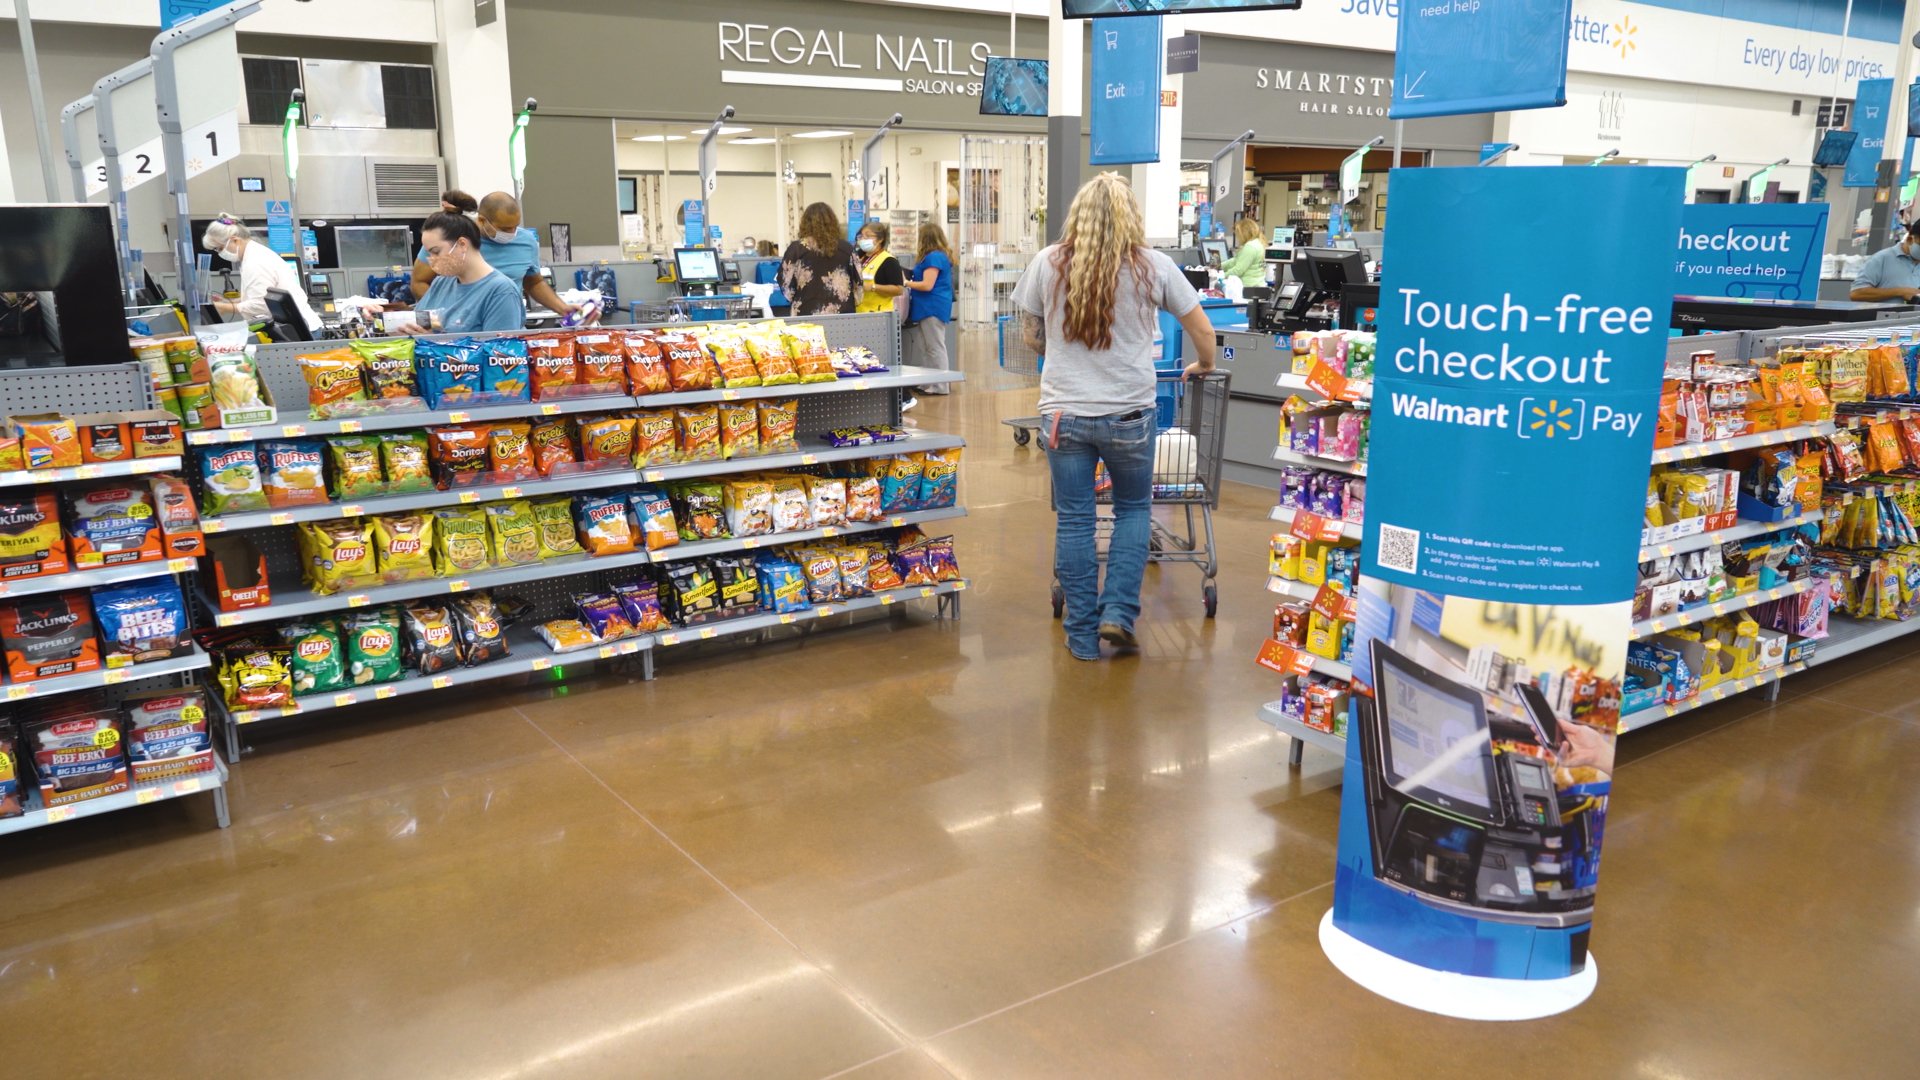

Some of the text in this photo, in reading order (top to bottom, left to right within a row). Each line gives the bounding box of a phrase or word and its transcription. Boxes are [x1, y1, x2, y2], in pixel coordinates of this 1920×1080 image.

[1420, 1, 1480, 17] need help
[718, 22, 992, 77] REGAL NAILS
[1744, 38, 1786, 74] Every
[1790, 45, 1815, 78] day
[905, 79, 953, 95] SALON
[1106, 83, 1126, 99] Exit
[1300, 102, 1338, 114] HAIR
[206, 131, 218, 156] 1
[1862, 139, 1884, 148] Exit
[136, 154, 151, 173] 2
[97, 166, 107, 182] 3
[708, 180, 714, 190] 6
[871, 180, 877, 190] 7
[1220, 186, 1226, 195] 9
[1688, 265, 1713, 277] you
[1716, 264, 1751, 276] need
[1755, 264, 1787, 280] help
[1398, 288, 1653, 334] Touch-free
[372, 360, 411, 371] Doritos
[489, 355, 528, 367] Doritos
[537, 356, 574, 367] Doritos
[585, 354, 623, 364] Doritos
[1395, 337, 1612, 384] checkout
[440, 362, 480, 373] Doritos
[317, 367, 360, 390] Cheetos
[1391, 392, 1642, 438] Walmart Pay
[209, 450, 255, 470] RUFFLES
[272, 451, 320, 468] RUFFLES
[87, 518, 138, 530] BEEF JERKY
[391, 538, 419, 553] Lay's
[1432, 533, 1447, 542] Scan
[1448, 536, 1460, 544] this
[1502, 543, 1536, 551] download
[335, 546, 365, 561] Lay's
[1464, 554, 1485, 562] select
[1486, 556, 1517, 566] Services,
[1582, 560, 1593, 568] Pay
[1428, 571, 1444, 579] Scan
[684, 585, 715, 603] Smartfood
[725, 581, 758, 596] Smartfood
[120, 608, 165, 628] BEEF
[15, 622, 45, 634] JACK
[118, 621, 175, 641] BITES
[426, 626, 450, 641] Lay's
[477, 620, 495, 633] Lay's
[27, 636, 75, 652] PEPPERED
[300, 640, 330, 655] Lay's
[361, 634, 391, 649] Lay's
[184, 711, 202, 720] BAG
[186, 707, 199, 715] BIG
[98, 730, 114, 739] BIG
[98, 735, 116, 745] BAG
[144, 724, 194, 741] BEEF JERKY
[149, 743, 162, 751] BIG
[162, 741, 176, 749] 3.25
[185, 736, 201, 745] BAG!
[53, 752, 76, 764] BEEF
[77, 749, 106, 761] JERKY
[57, 767, 71, 776] BIG
[72, 766, 87, 775] 3.25
[97, 762, 113, 771] BAG!
[135, 755, 210, 774] SWEET BABY RAY'S
[50, 782, 127, 806] SWEET BABY RAY'S
